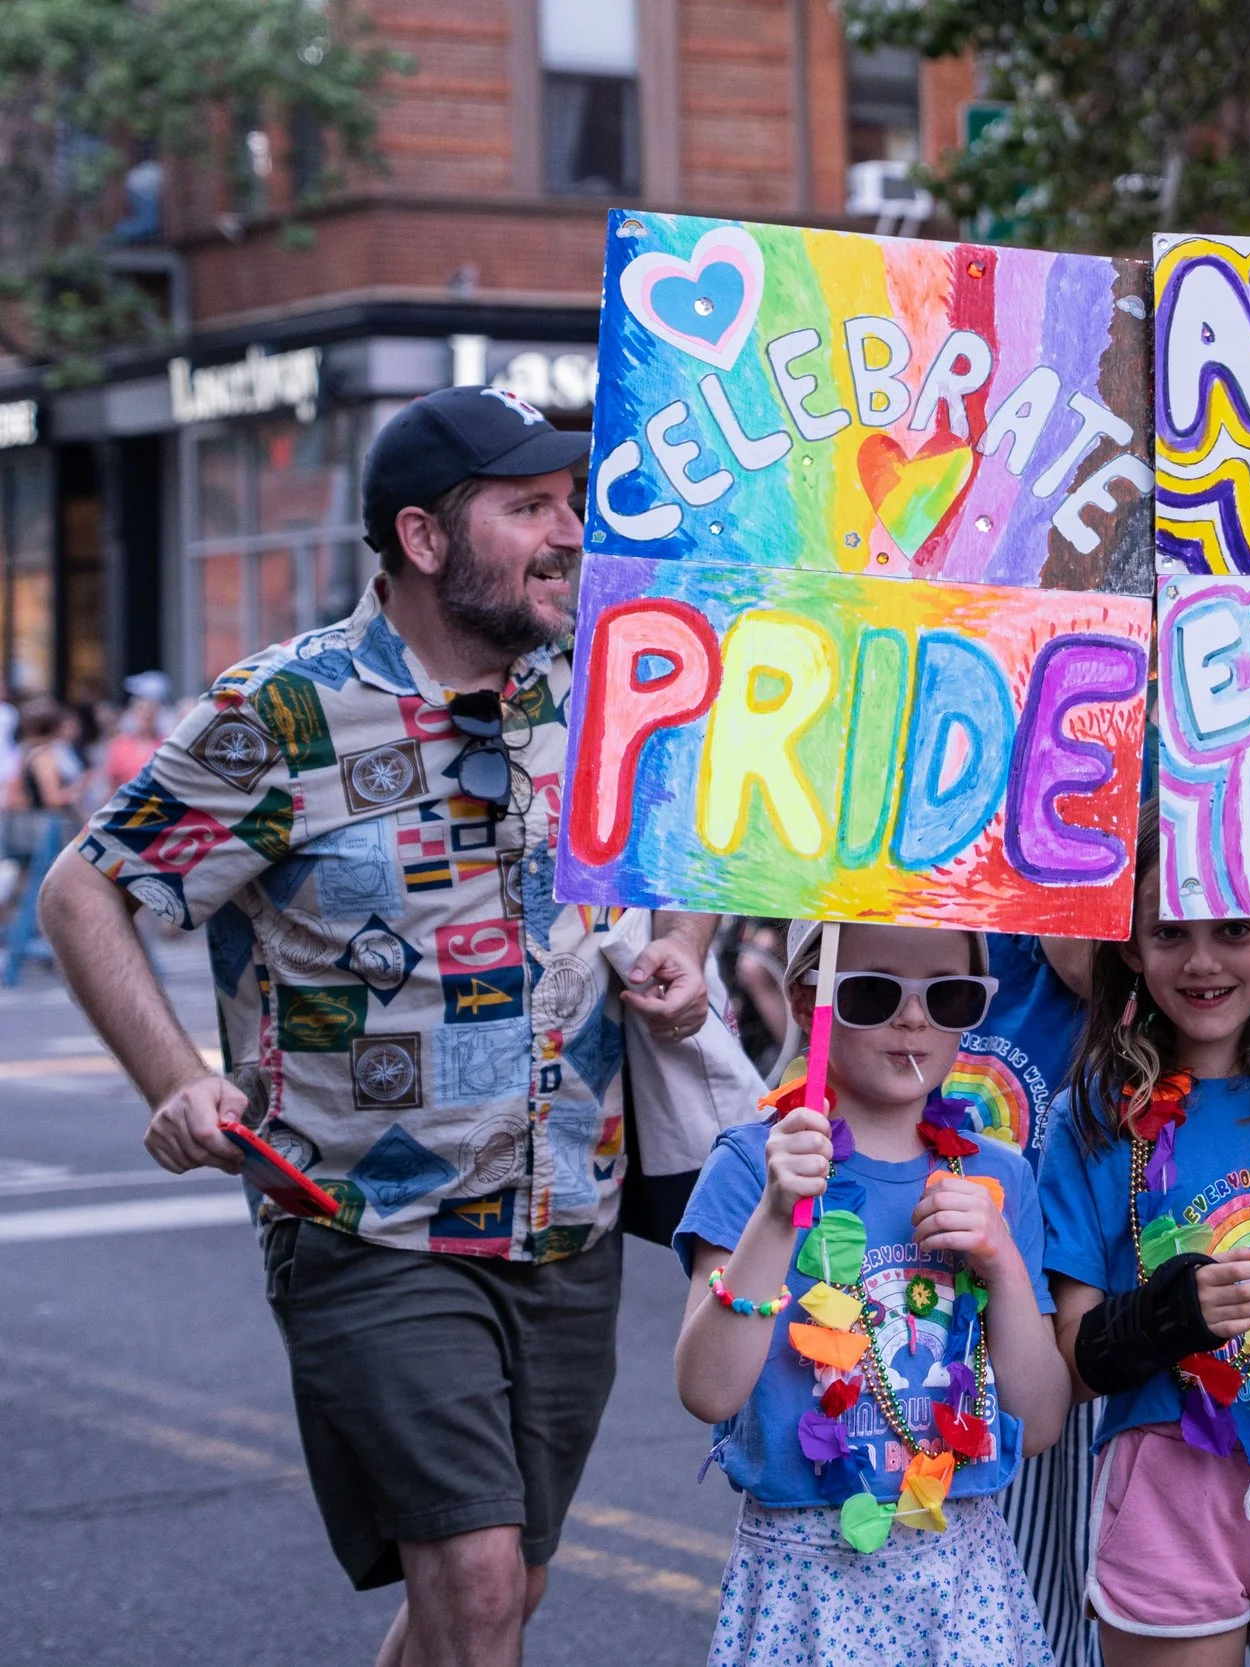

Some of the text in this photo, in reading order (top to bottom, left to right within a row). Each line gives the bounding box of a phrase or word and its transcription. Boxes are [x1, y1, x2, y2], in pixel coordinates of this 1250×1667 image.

[452, 334, 598, 410] Las
[597, 316, 1154, 553] CELEBRATE
[569, 597, 1147, 888] PRIDE
